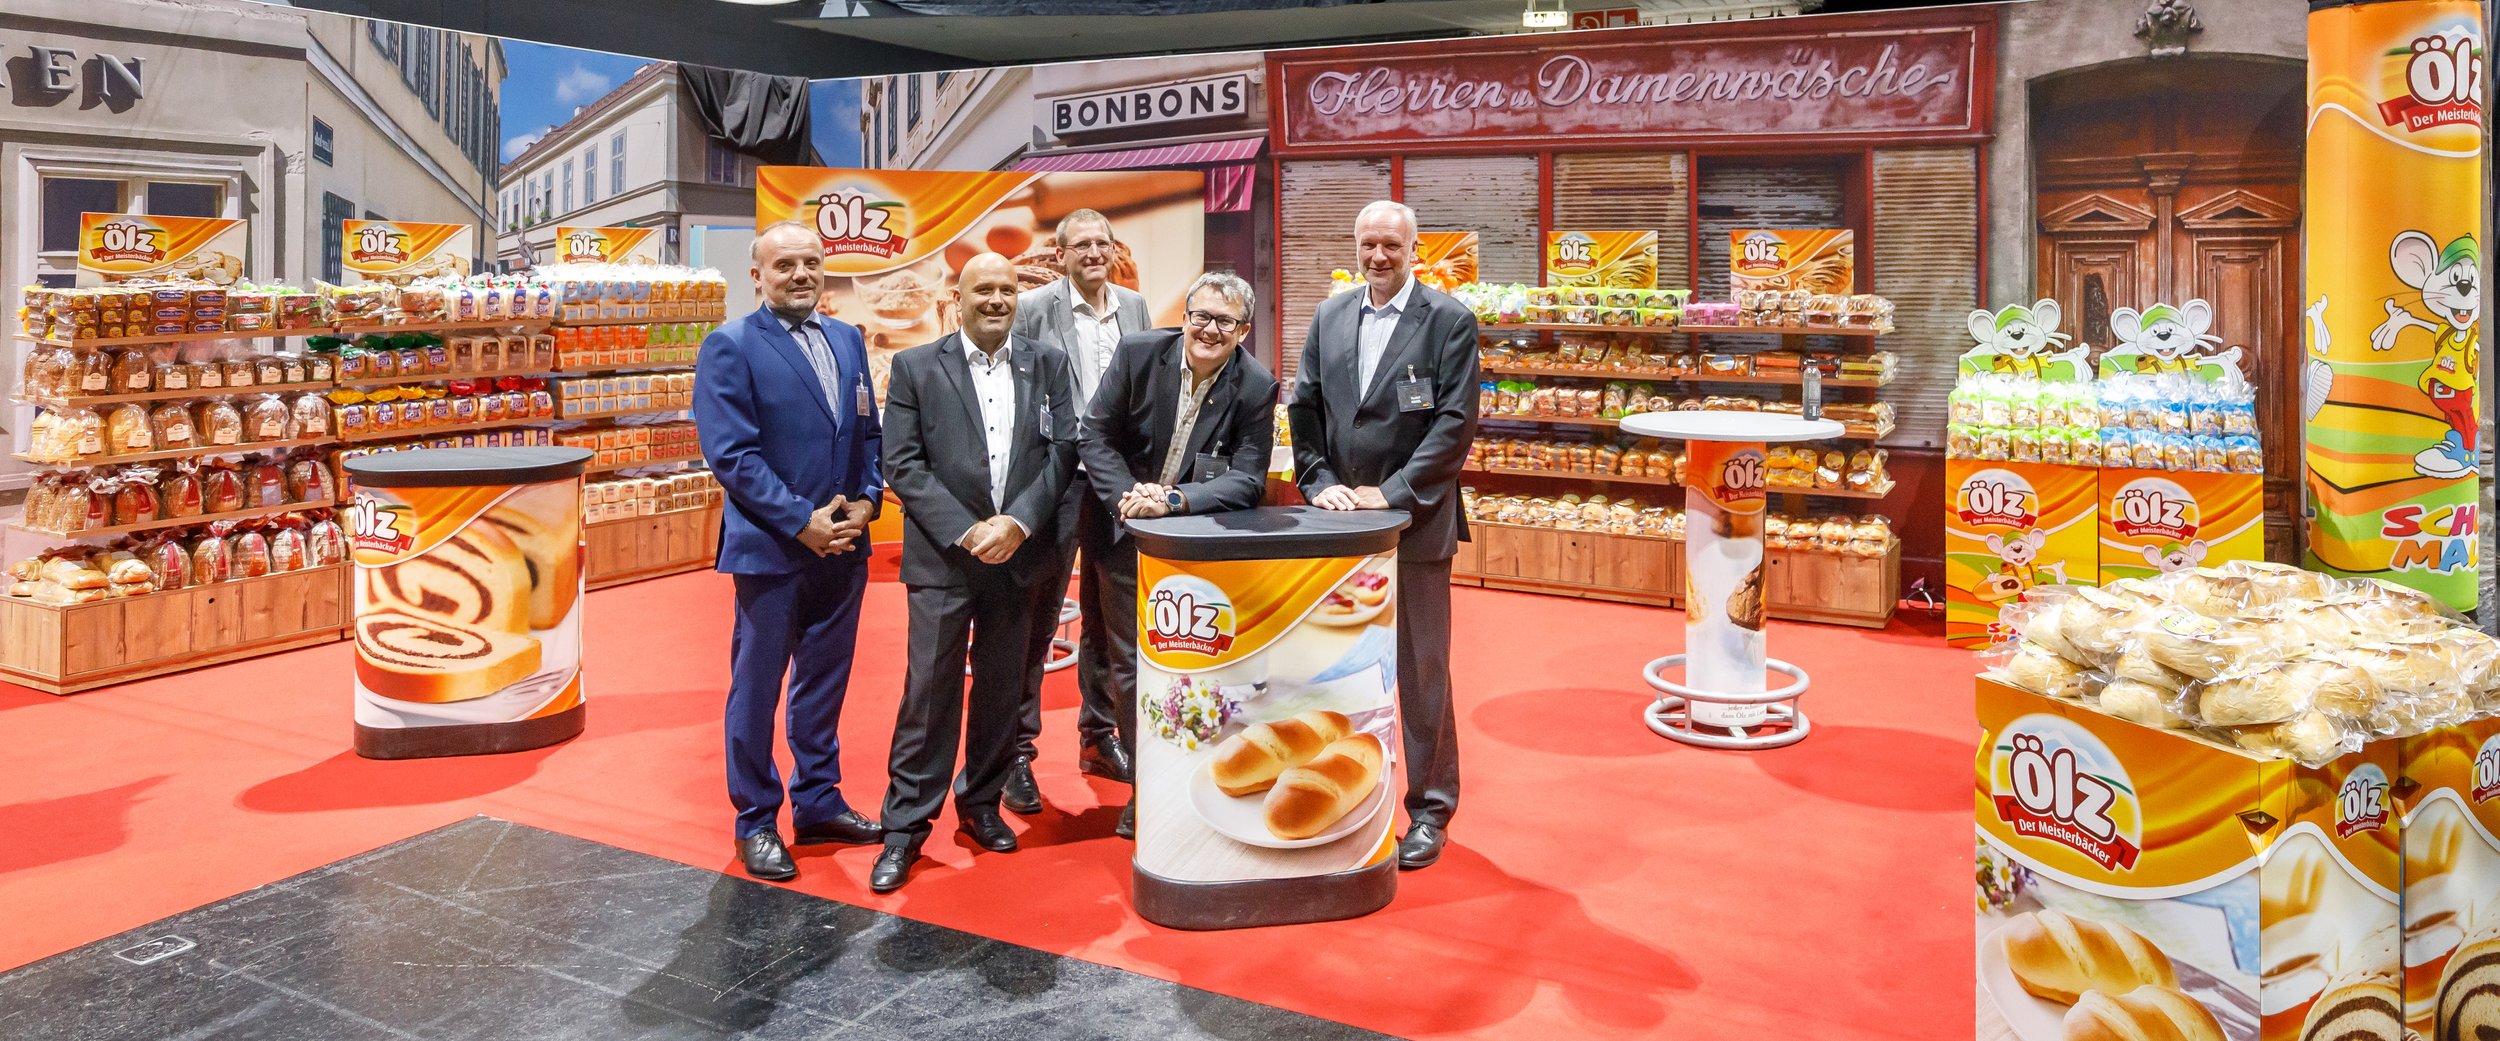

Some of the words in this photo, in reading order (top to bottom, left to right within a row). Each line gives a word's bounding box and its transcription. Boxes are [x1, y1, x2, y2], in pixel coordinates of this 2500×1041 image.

[0, 43, 147, 100] EN
[1309, 66, 1507, 115] Herren
[1510, 87, 1535, 108] u.
[1537, 44, 1953, 107] Damenwäsche
[1056, 80, 1240, 130] BONBONS
[2412, 113, 2434, 128] Der
[816, 193, 892, 242] Ölz
[103, 223, 156, 253] Ölz
[361, 229, 401, 255] Ölz
[570, 234, 602, 256] Ölz
[835, 243, 889, 255] Meisterbäcker
[1558, 239, 1592, 262] Ölz
[1744, 239, 1780, 262] Ölz
[1723, 458, 1764, 490] Ölz
[1968, 480, 2025, 518] Ölz
[2123, 489, 2185, 528] Ölz
[2140, 527, 2182, 538] Meisterbäcker
[1155, 590, 1219, 640] Ölz
[1158, 641, 1168, 649] Der
[1169, 640, 1215, 653] Meisterbäcker
[2010, 733, 2116, 842] Ölz
[2479, 749, 2500, 789] Öl
[2343, 778, 2382, 822] Ölz
[2019, 818, 2036, 832] Der
[2038, 820, 2111, 864] Meisterbäcker
